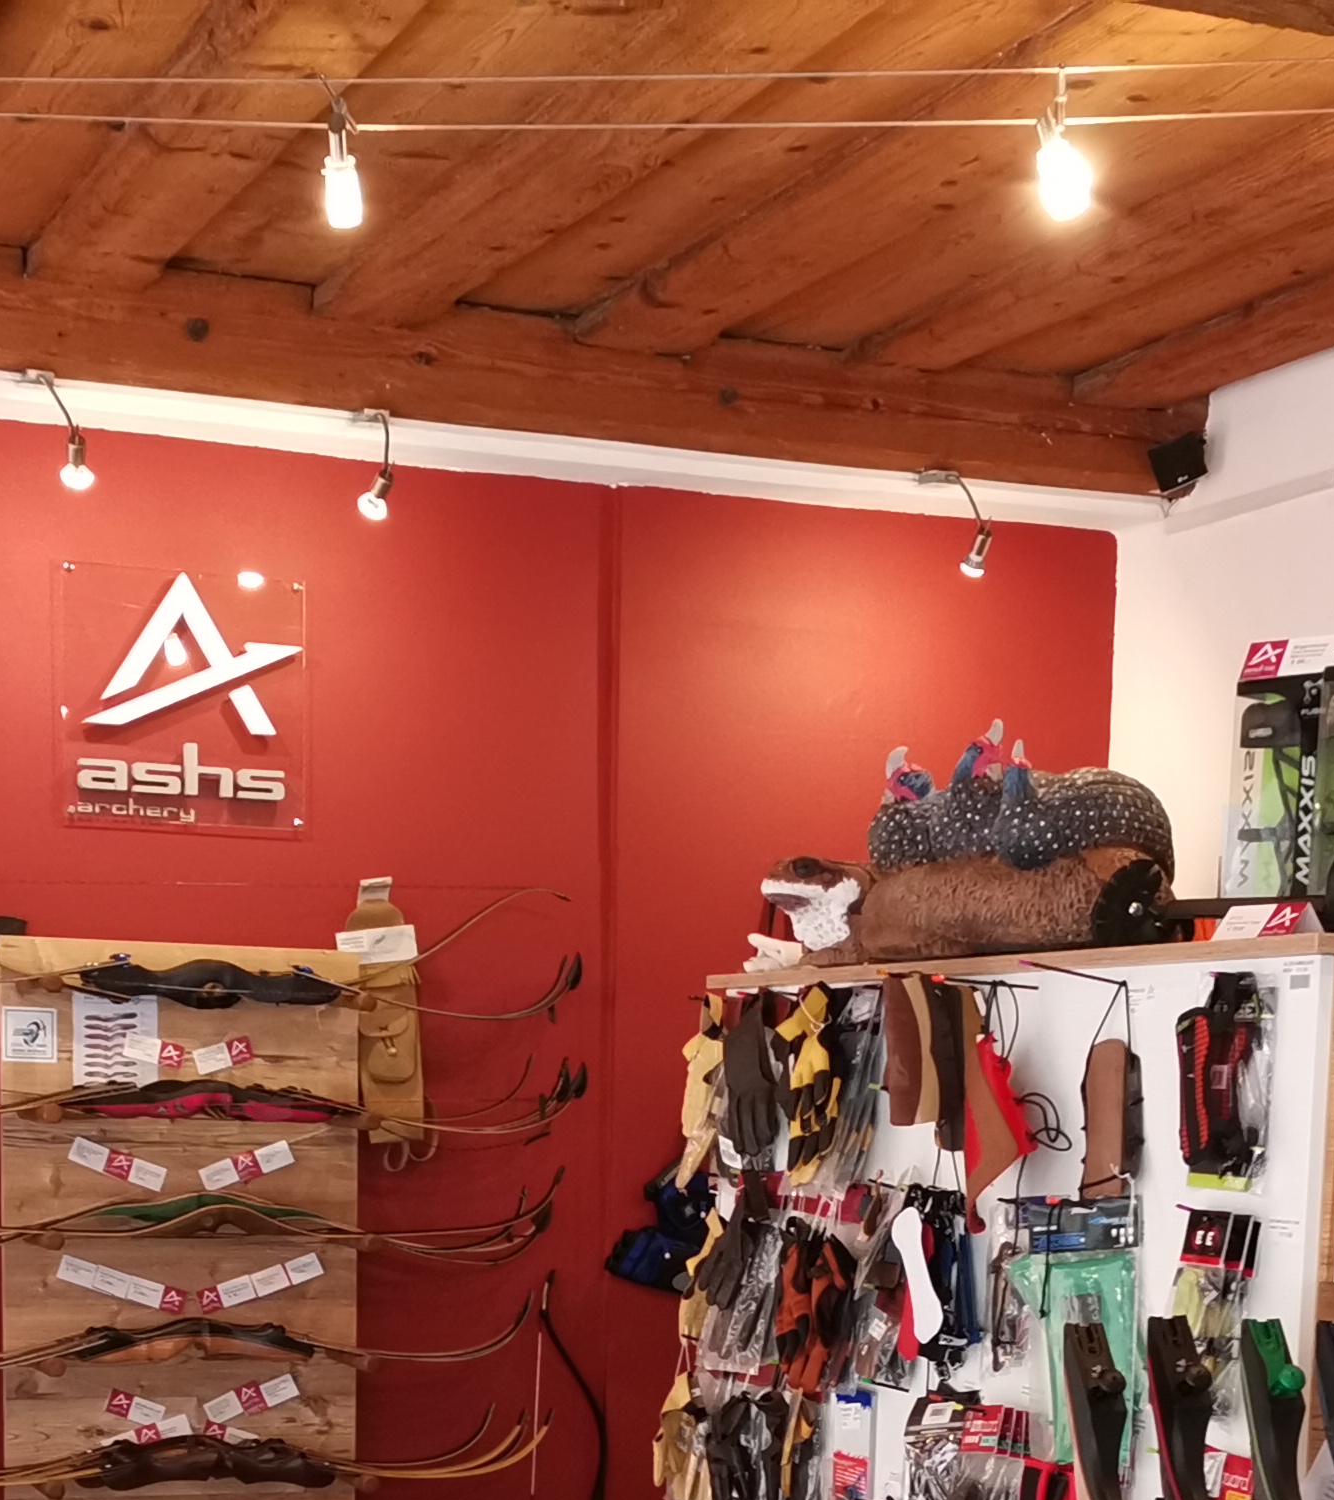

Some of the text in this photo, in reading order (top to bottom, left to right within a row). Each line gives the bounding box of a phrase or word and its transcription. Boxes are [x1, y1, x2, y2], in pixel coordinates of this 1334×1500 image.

[77, 742, 286, 801] ashs
[76, 798, 196, 822] archery
[1296, 754, 1317, 886] MAXXIS
